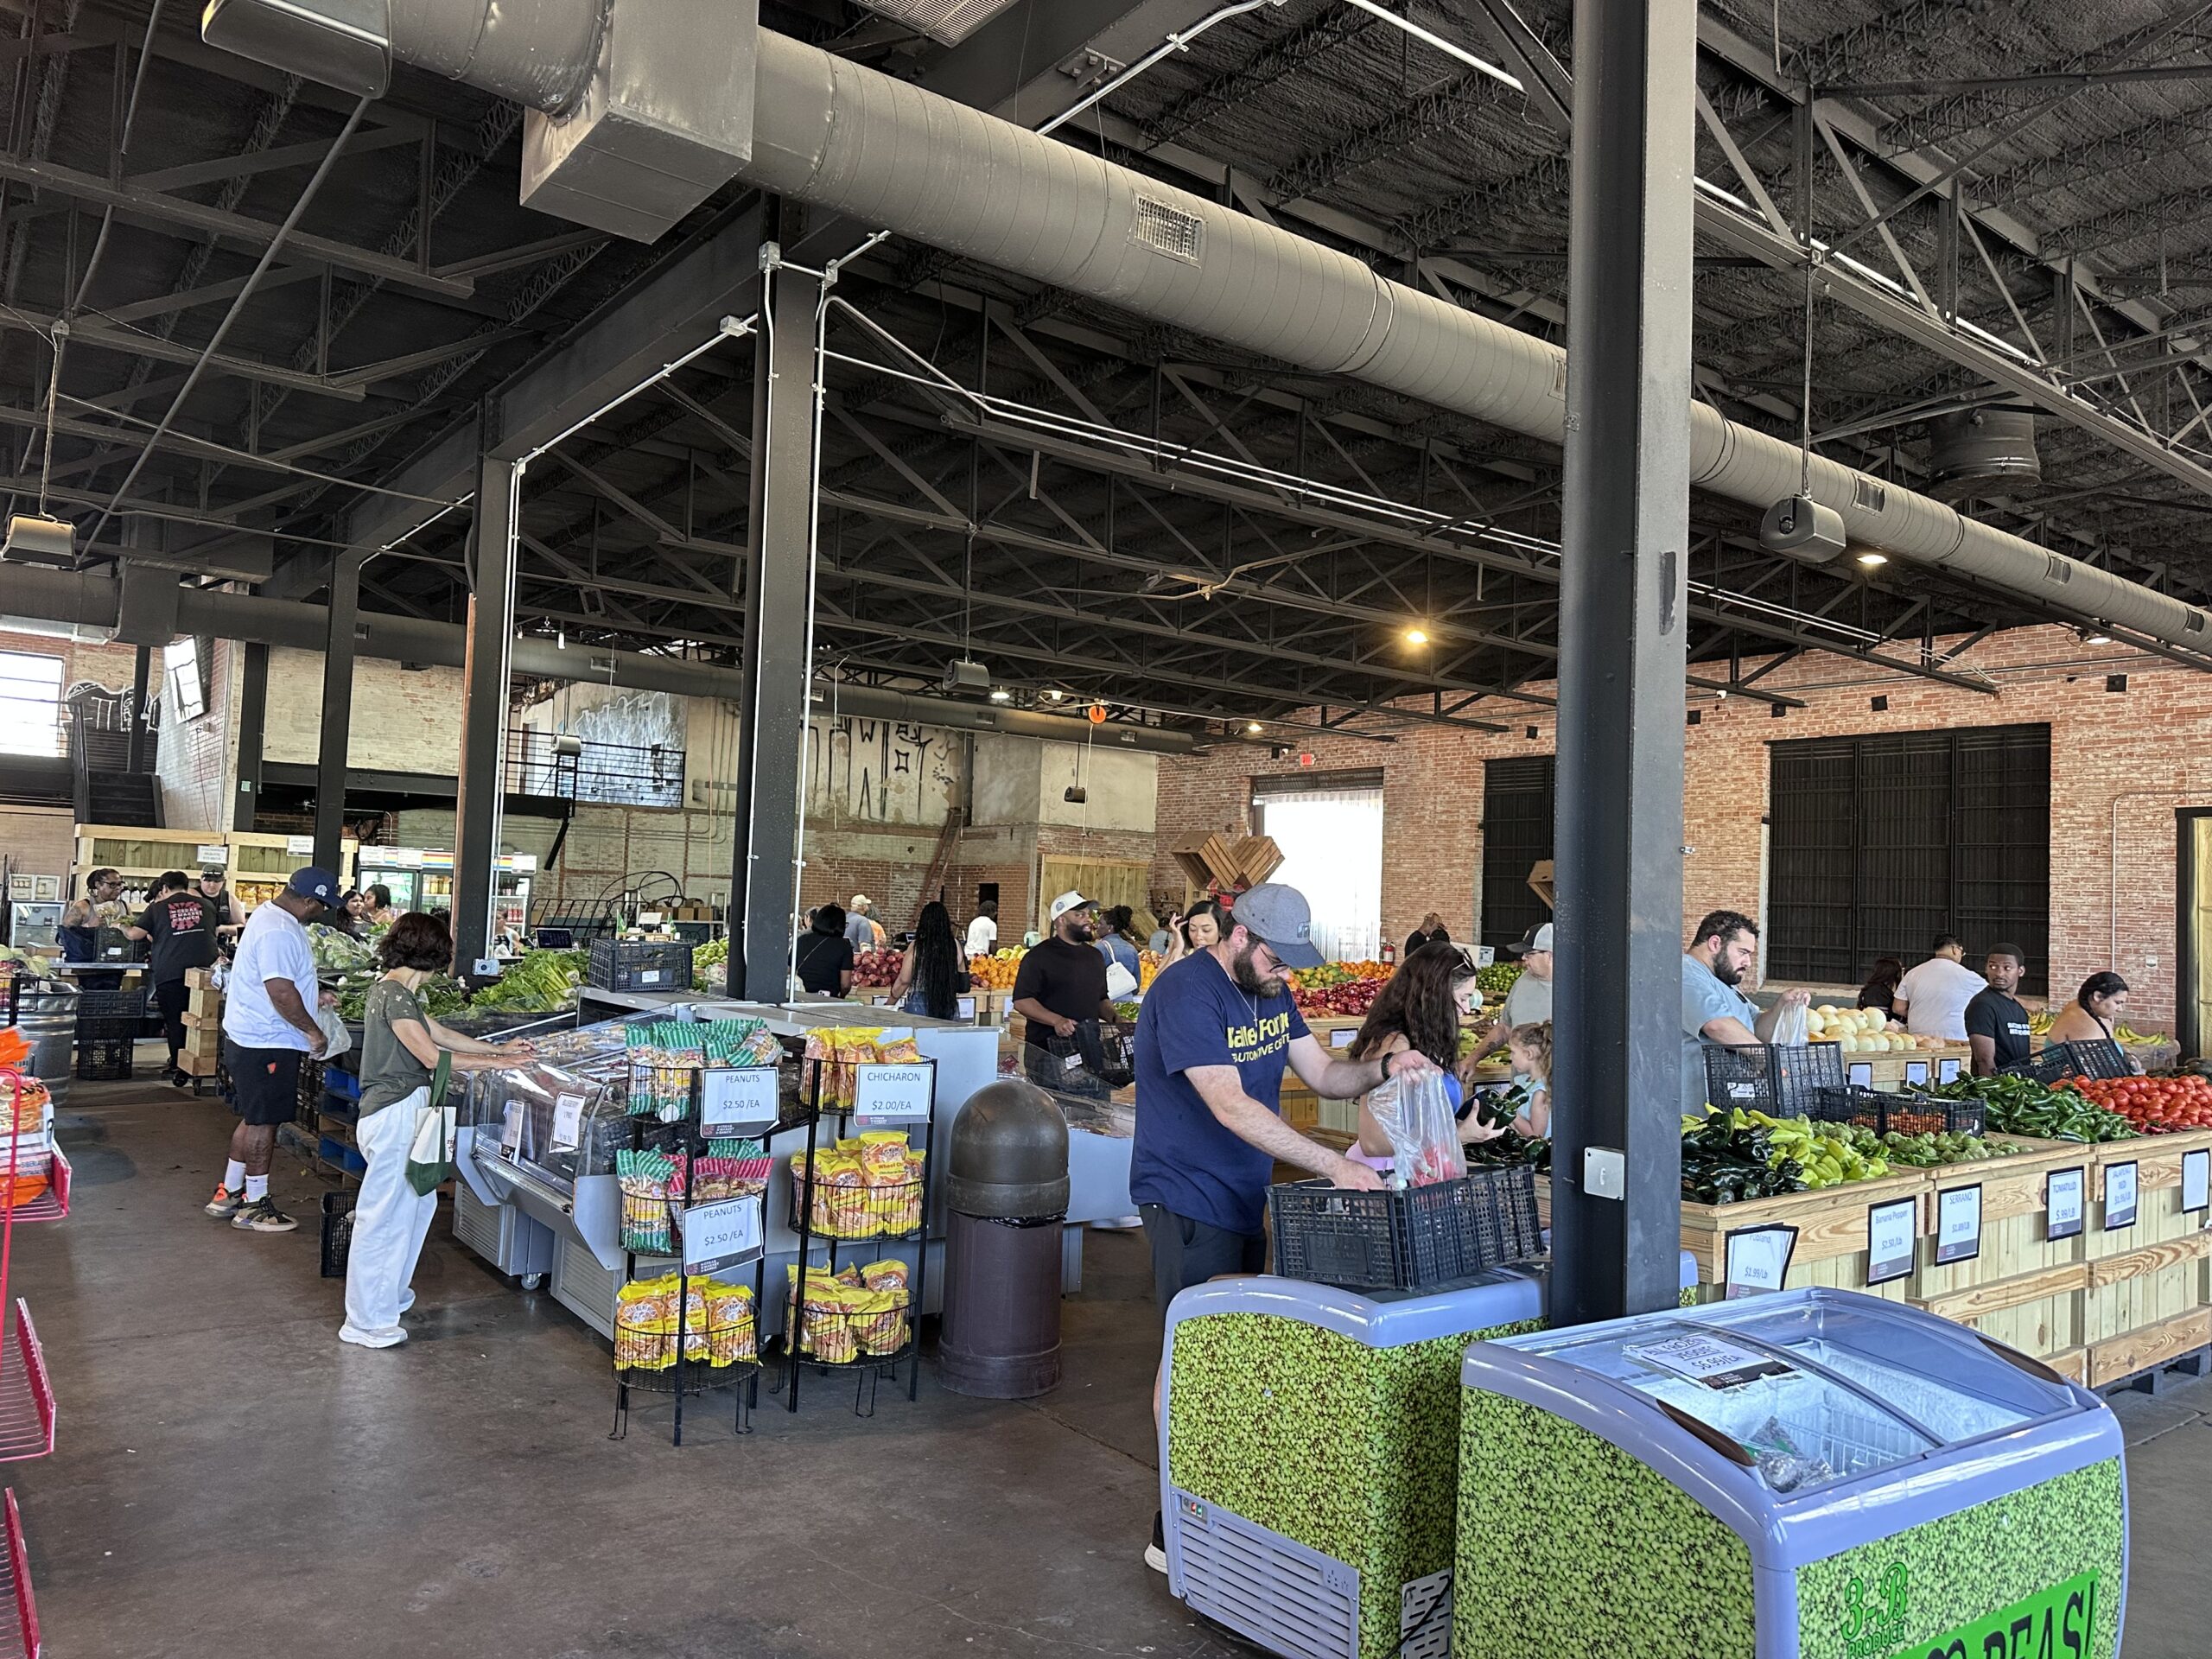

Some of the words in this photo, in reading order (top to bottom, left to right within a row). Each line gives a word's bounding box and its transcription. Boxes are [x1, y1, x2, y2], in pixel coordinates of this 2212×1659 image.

[726, 1074, 760, 1084] PEANUTS
[867, 1072, 921, 1082] CHICHARON
[722, 1098, 745, 1109] $2.50
[746, 1099, 760, 1109] /EA
[871, 1100, 912, 1111] $2.00/EA
[1949, 1192, 1973, 1205] SERRANO
[703, 1204, 742, 1220] PEANUTS
[1875, 1214, 1892, 1224] Banana
[704, 1233, 728, 1247] $2.50
[729, 1230, 744, 1242] /EA
[1745, 1266, 1768, 1280] $1.99/Lb
[1643, 1347, 1661, 1356] ALL
[1691, 1353, 1745, 1370] $6.99/EA
[1847, 1620, 1905, 1659] PRODUCE
